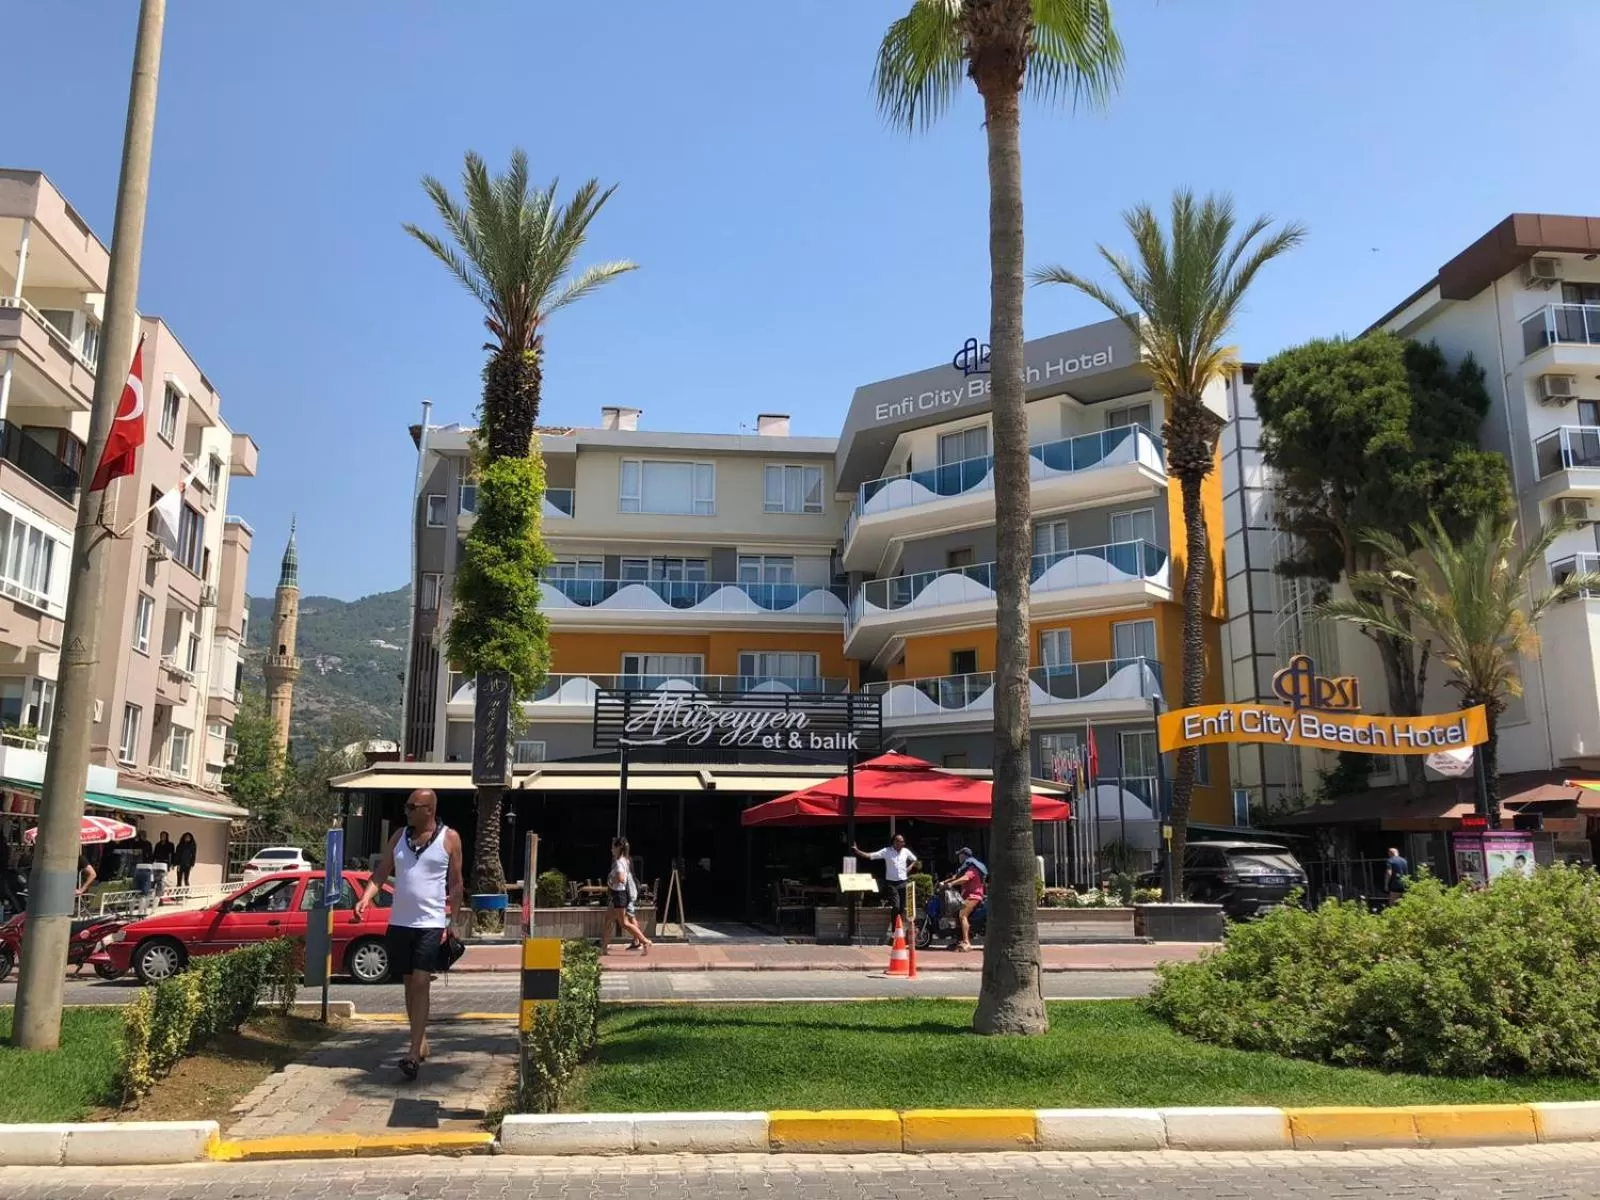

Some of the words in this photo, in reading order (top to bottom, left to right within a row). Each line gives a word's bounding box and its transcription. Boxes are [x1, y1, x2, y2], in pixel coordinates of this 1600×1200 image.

[874, 396, 915, 421] Enfi
[918, 386, 964, 411] City
[968, 361, 1040, 399] Beh
[1045, 345, 1113, 380] Hotel
[619, 690, 810, 746] Müzeyyen
[762, 732, 781, 748] et
[788, 732, 803, 748] &
[1183, 709, 1233, 740] Enfi
[1240, 708, 1296, 742] City
[1300, 713, 1388, 747] Beach
[1393, 718, 1469, 748] Hotel
